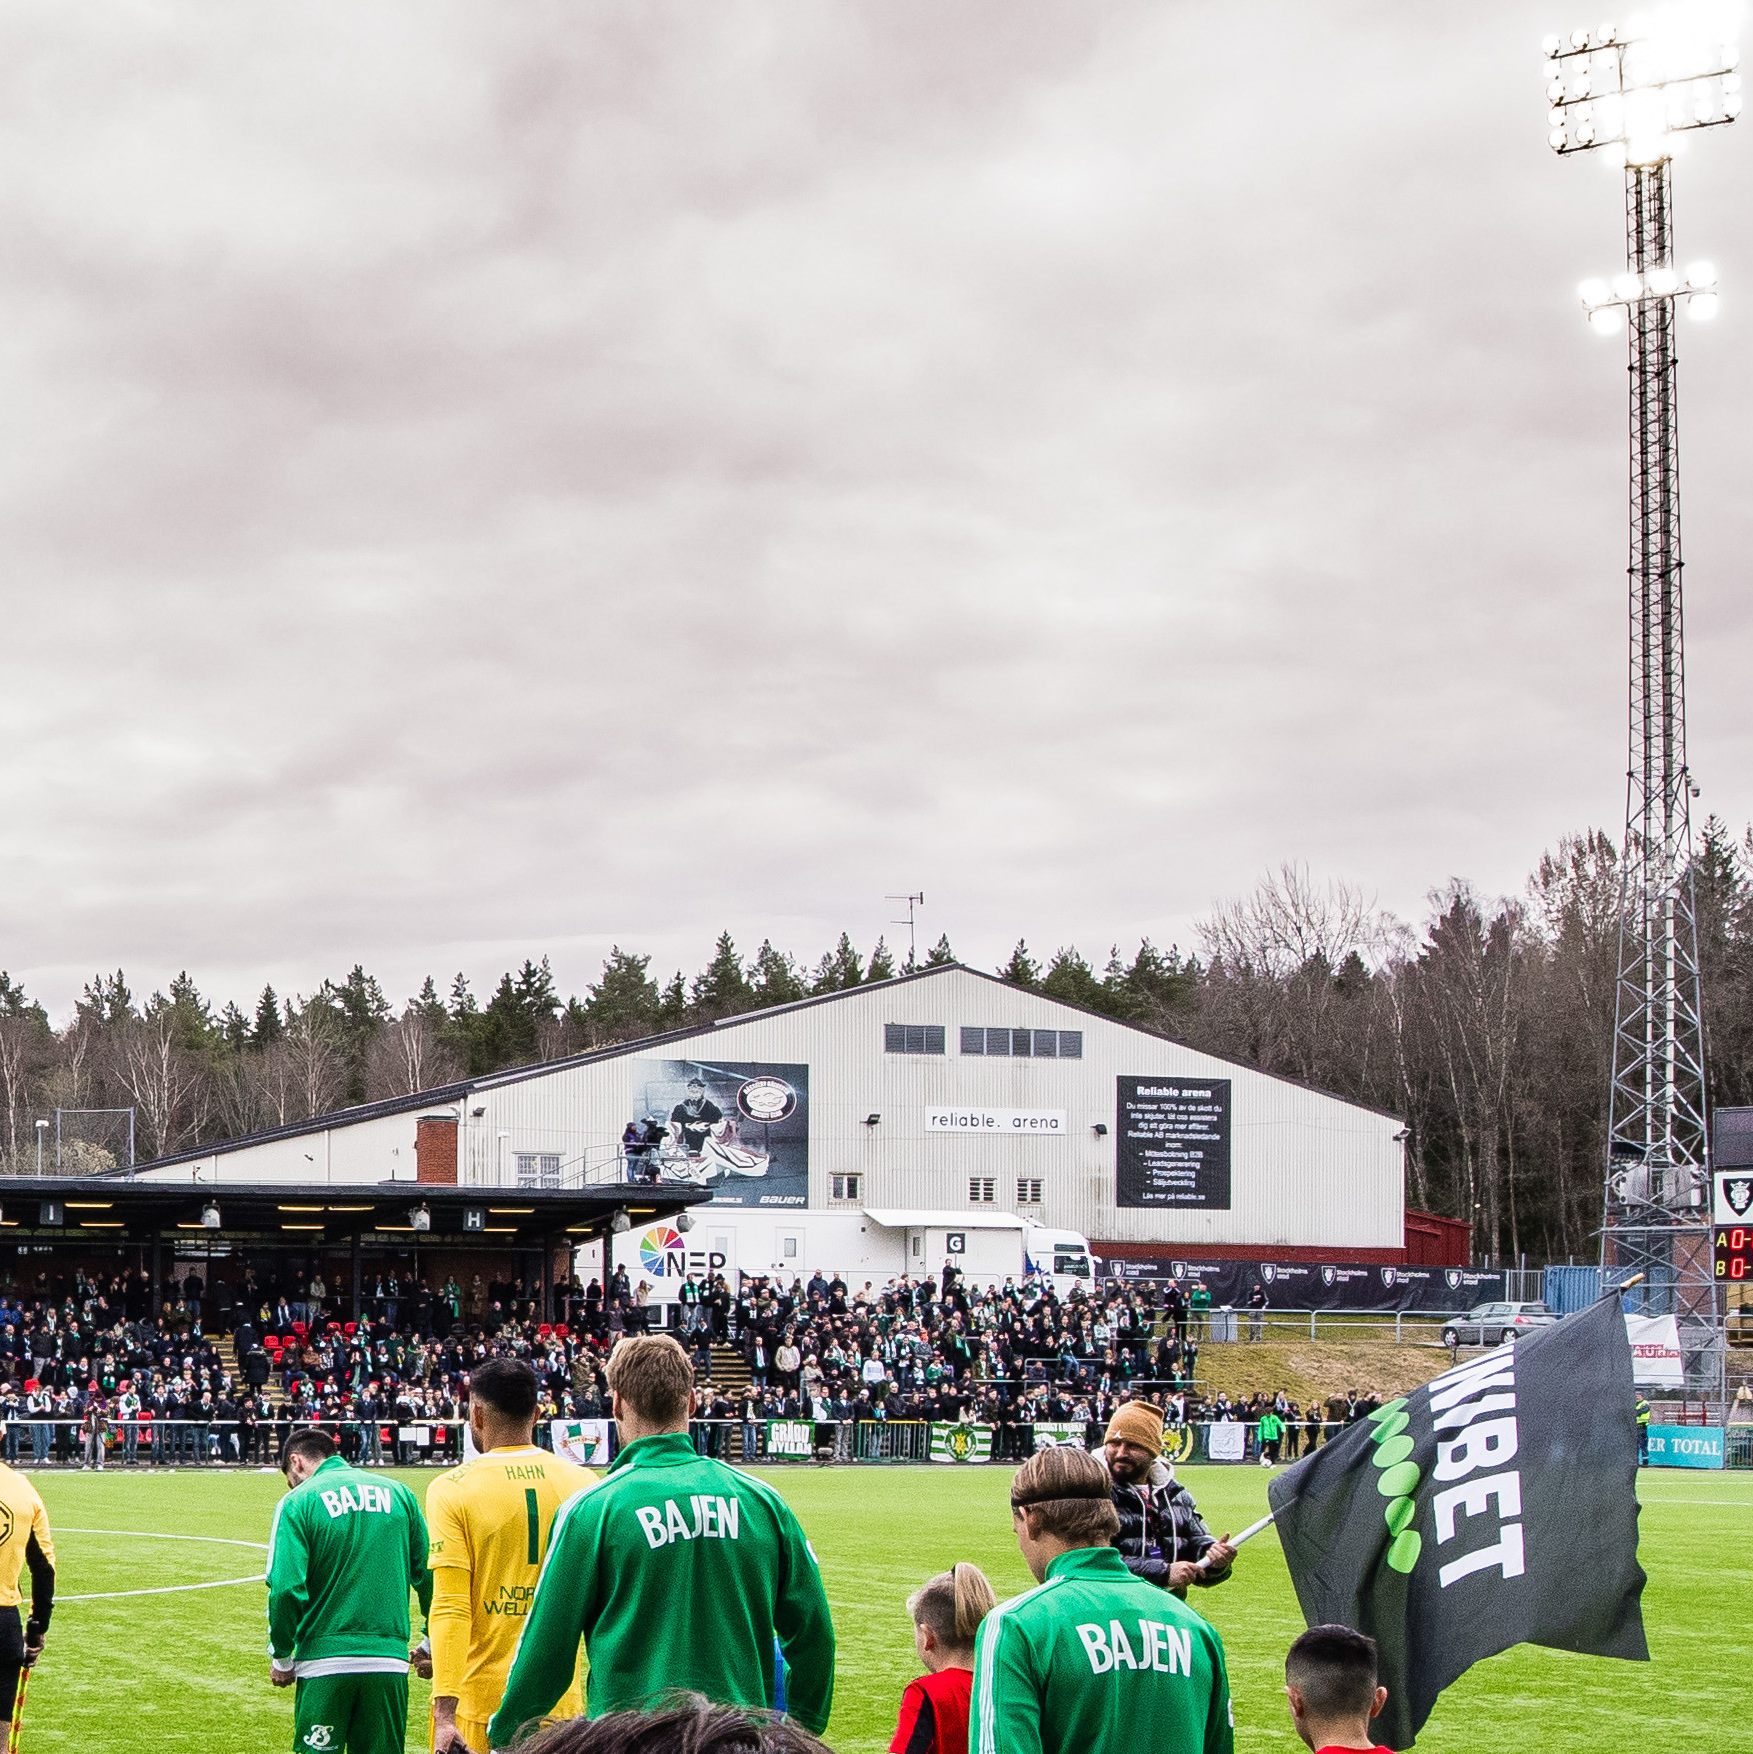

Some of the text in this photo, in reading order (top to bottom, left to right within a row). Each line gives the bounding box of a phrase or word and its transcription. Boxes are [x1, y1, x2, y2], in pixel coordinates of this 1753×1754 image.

[1136, 1086, 1211, 1098] Reliable arena
[1012, 1116, 1059, 1130] arena
[467, 1212, 480, 1227] H
[949, 1236, 962, 1251] G
[1716, 1232, 1727, 1248] A
[1715, 1260, 1726, 1276] B
[1671, 1438, 1721, 1456] TOTAL
[505, 1464, 546, 1480] HAHN
[319, 1485, 392, 1520] BAJEN
[524, 1488, 539, 1565] 1
[636, 1493, 739, 1550] BAJEN
[1075, 1618, 1193, 1678] BAJEN
